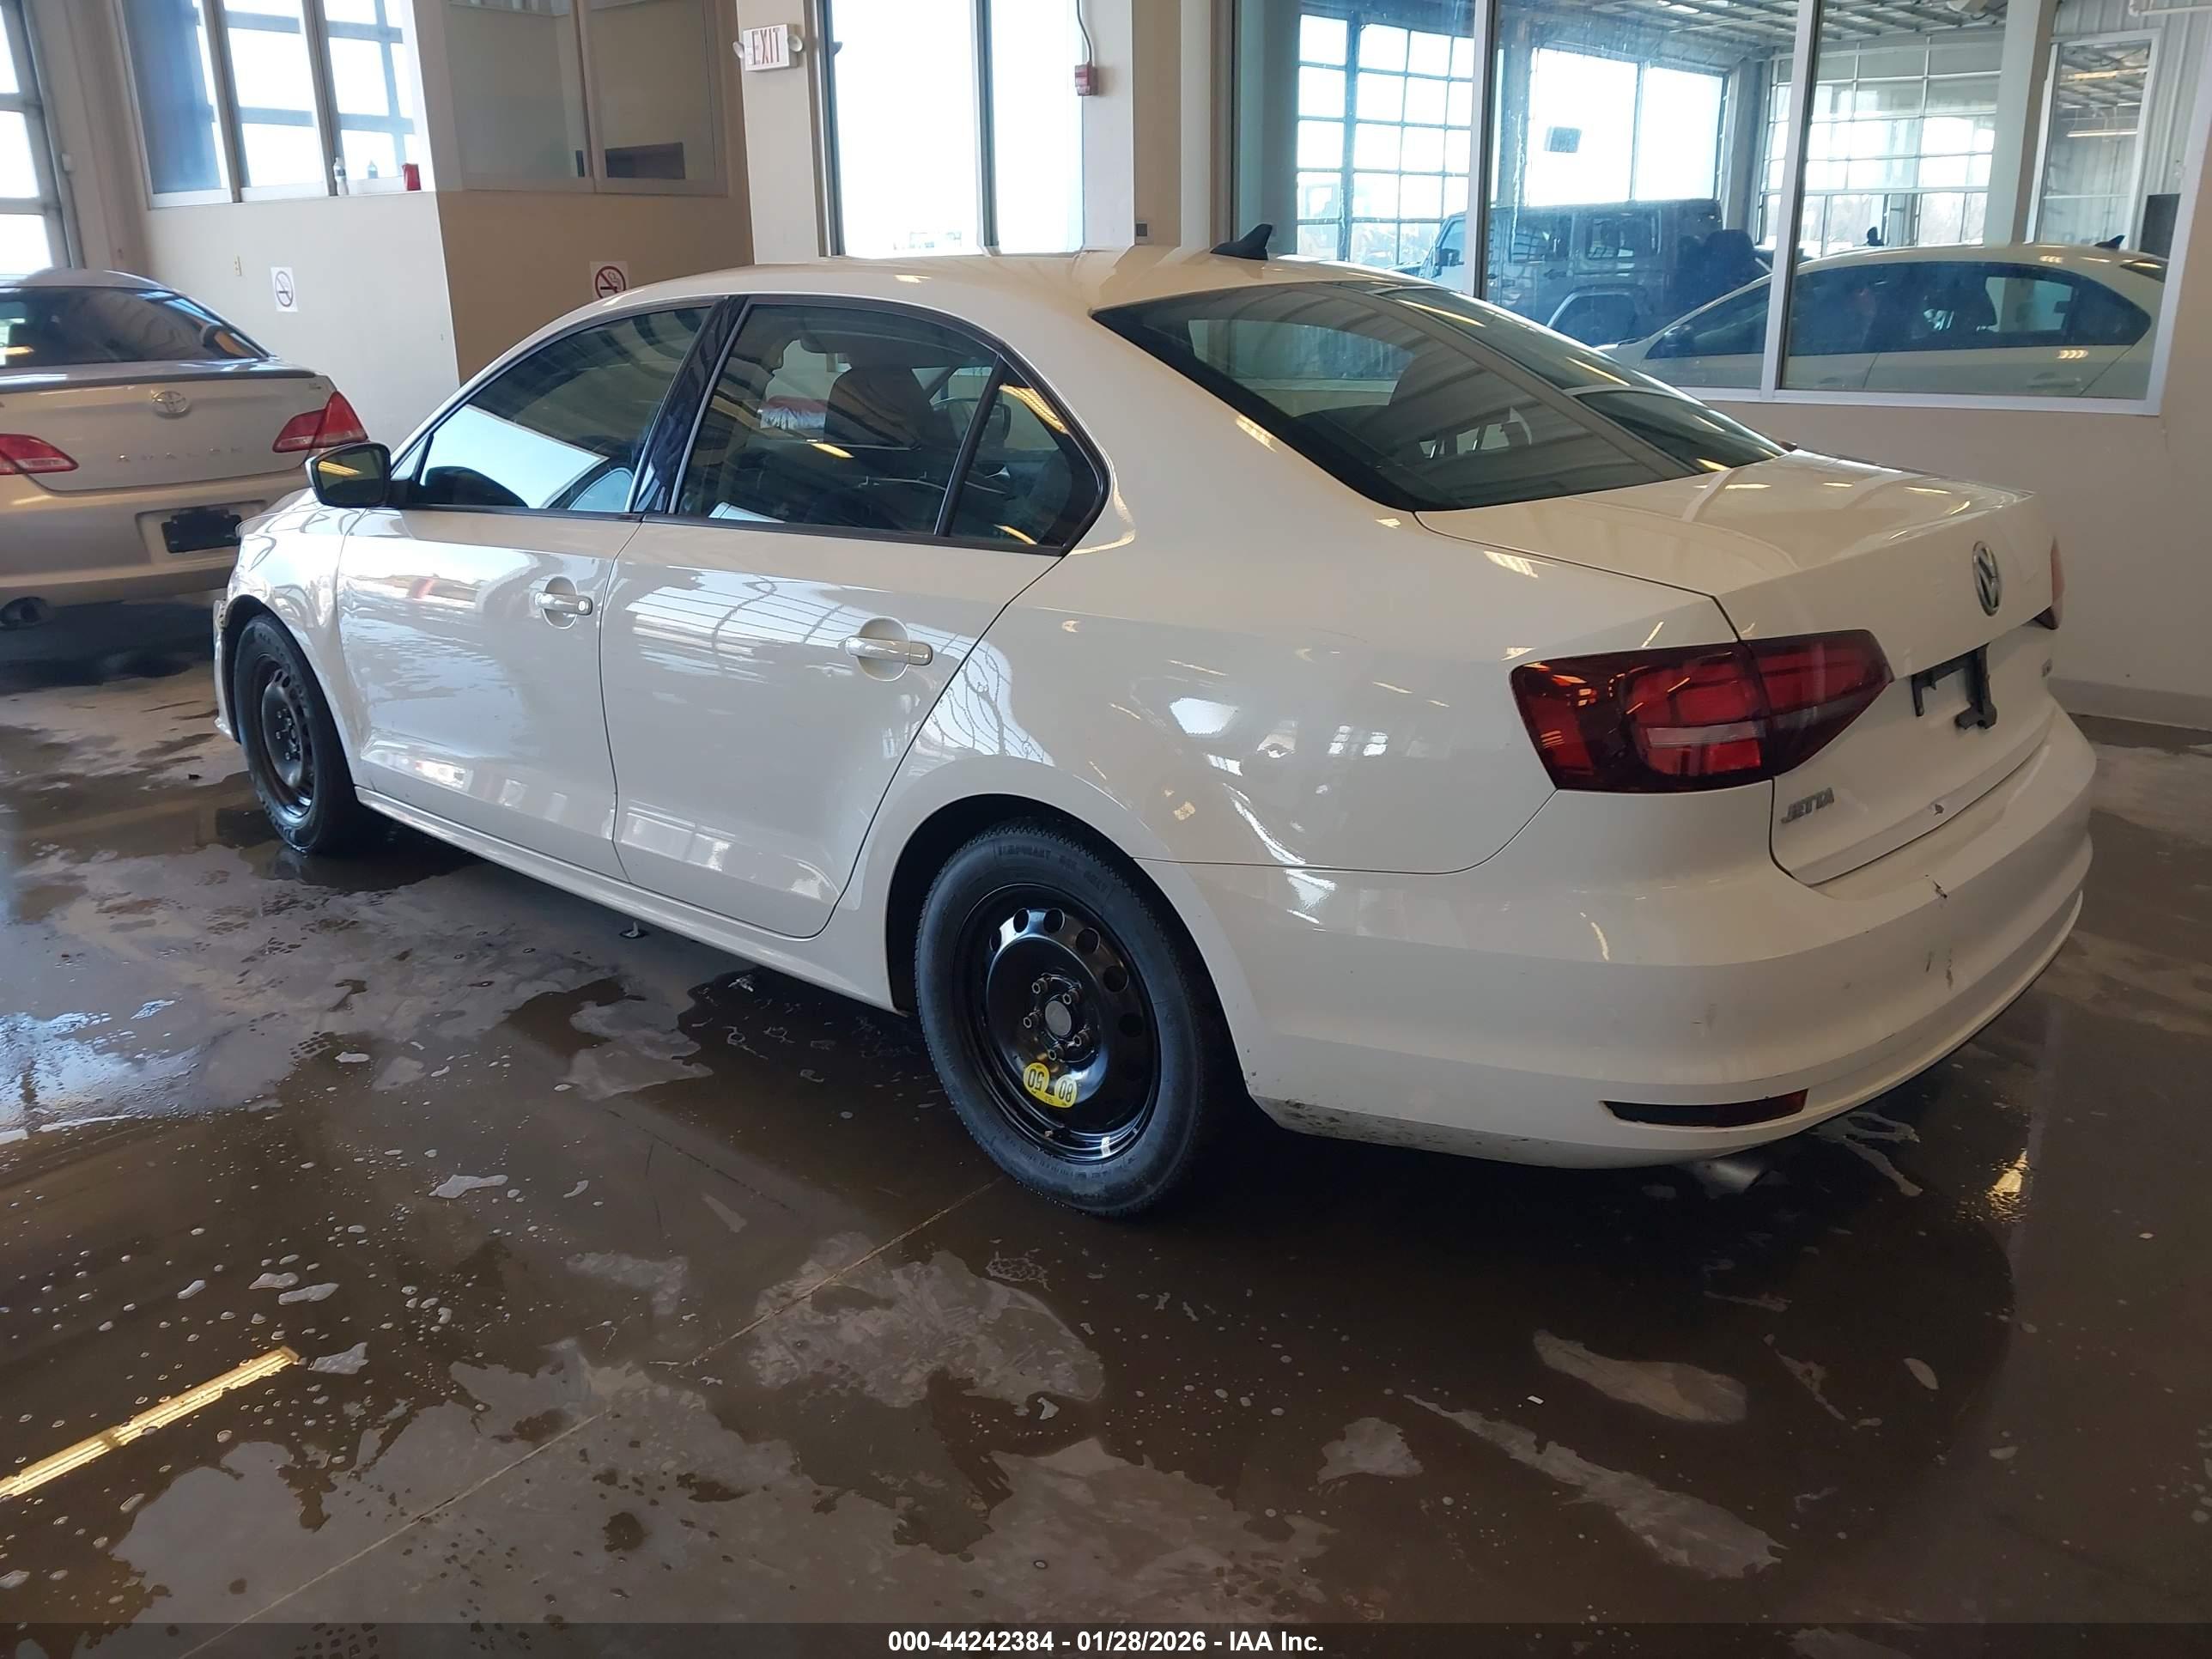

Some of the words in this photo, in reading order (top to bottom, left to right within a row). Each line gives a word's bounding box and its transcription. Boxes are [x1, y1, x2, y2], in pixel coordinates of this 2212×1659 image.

[752, 27, 781, 65] EXIT
[1780, 787, 1835, 823] JETTA
[1028, 1068, 1045, 1091] 50
[1059, 1080, 1073, 1103] 80
